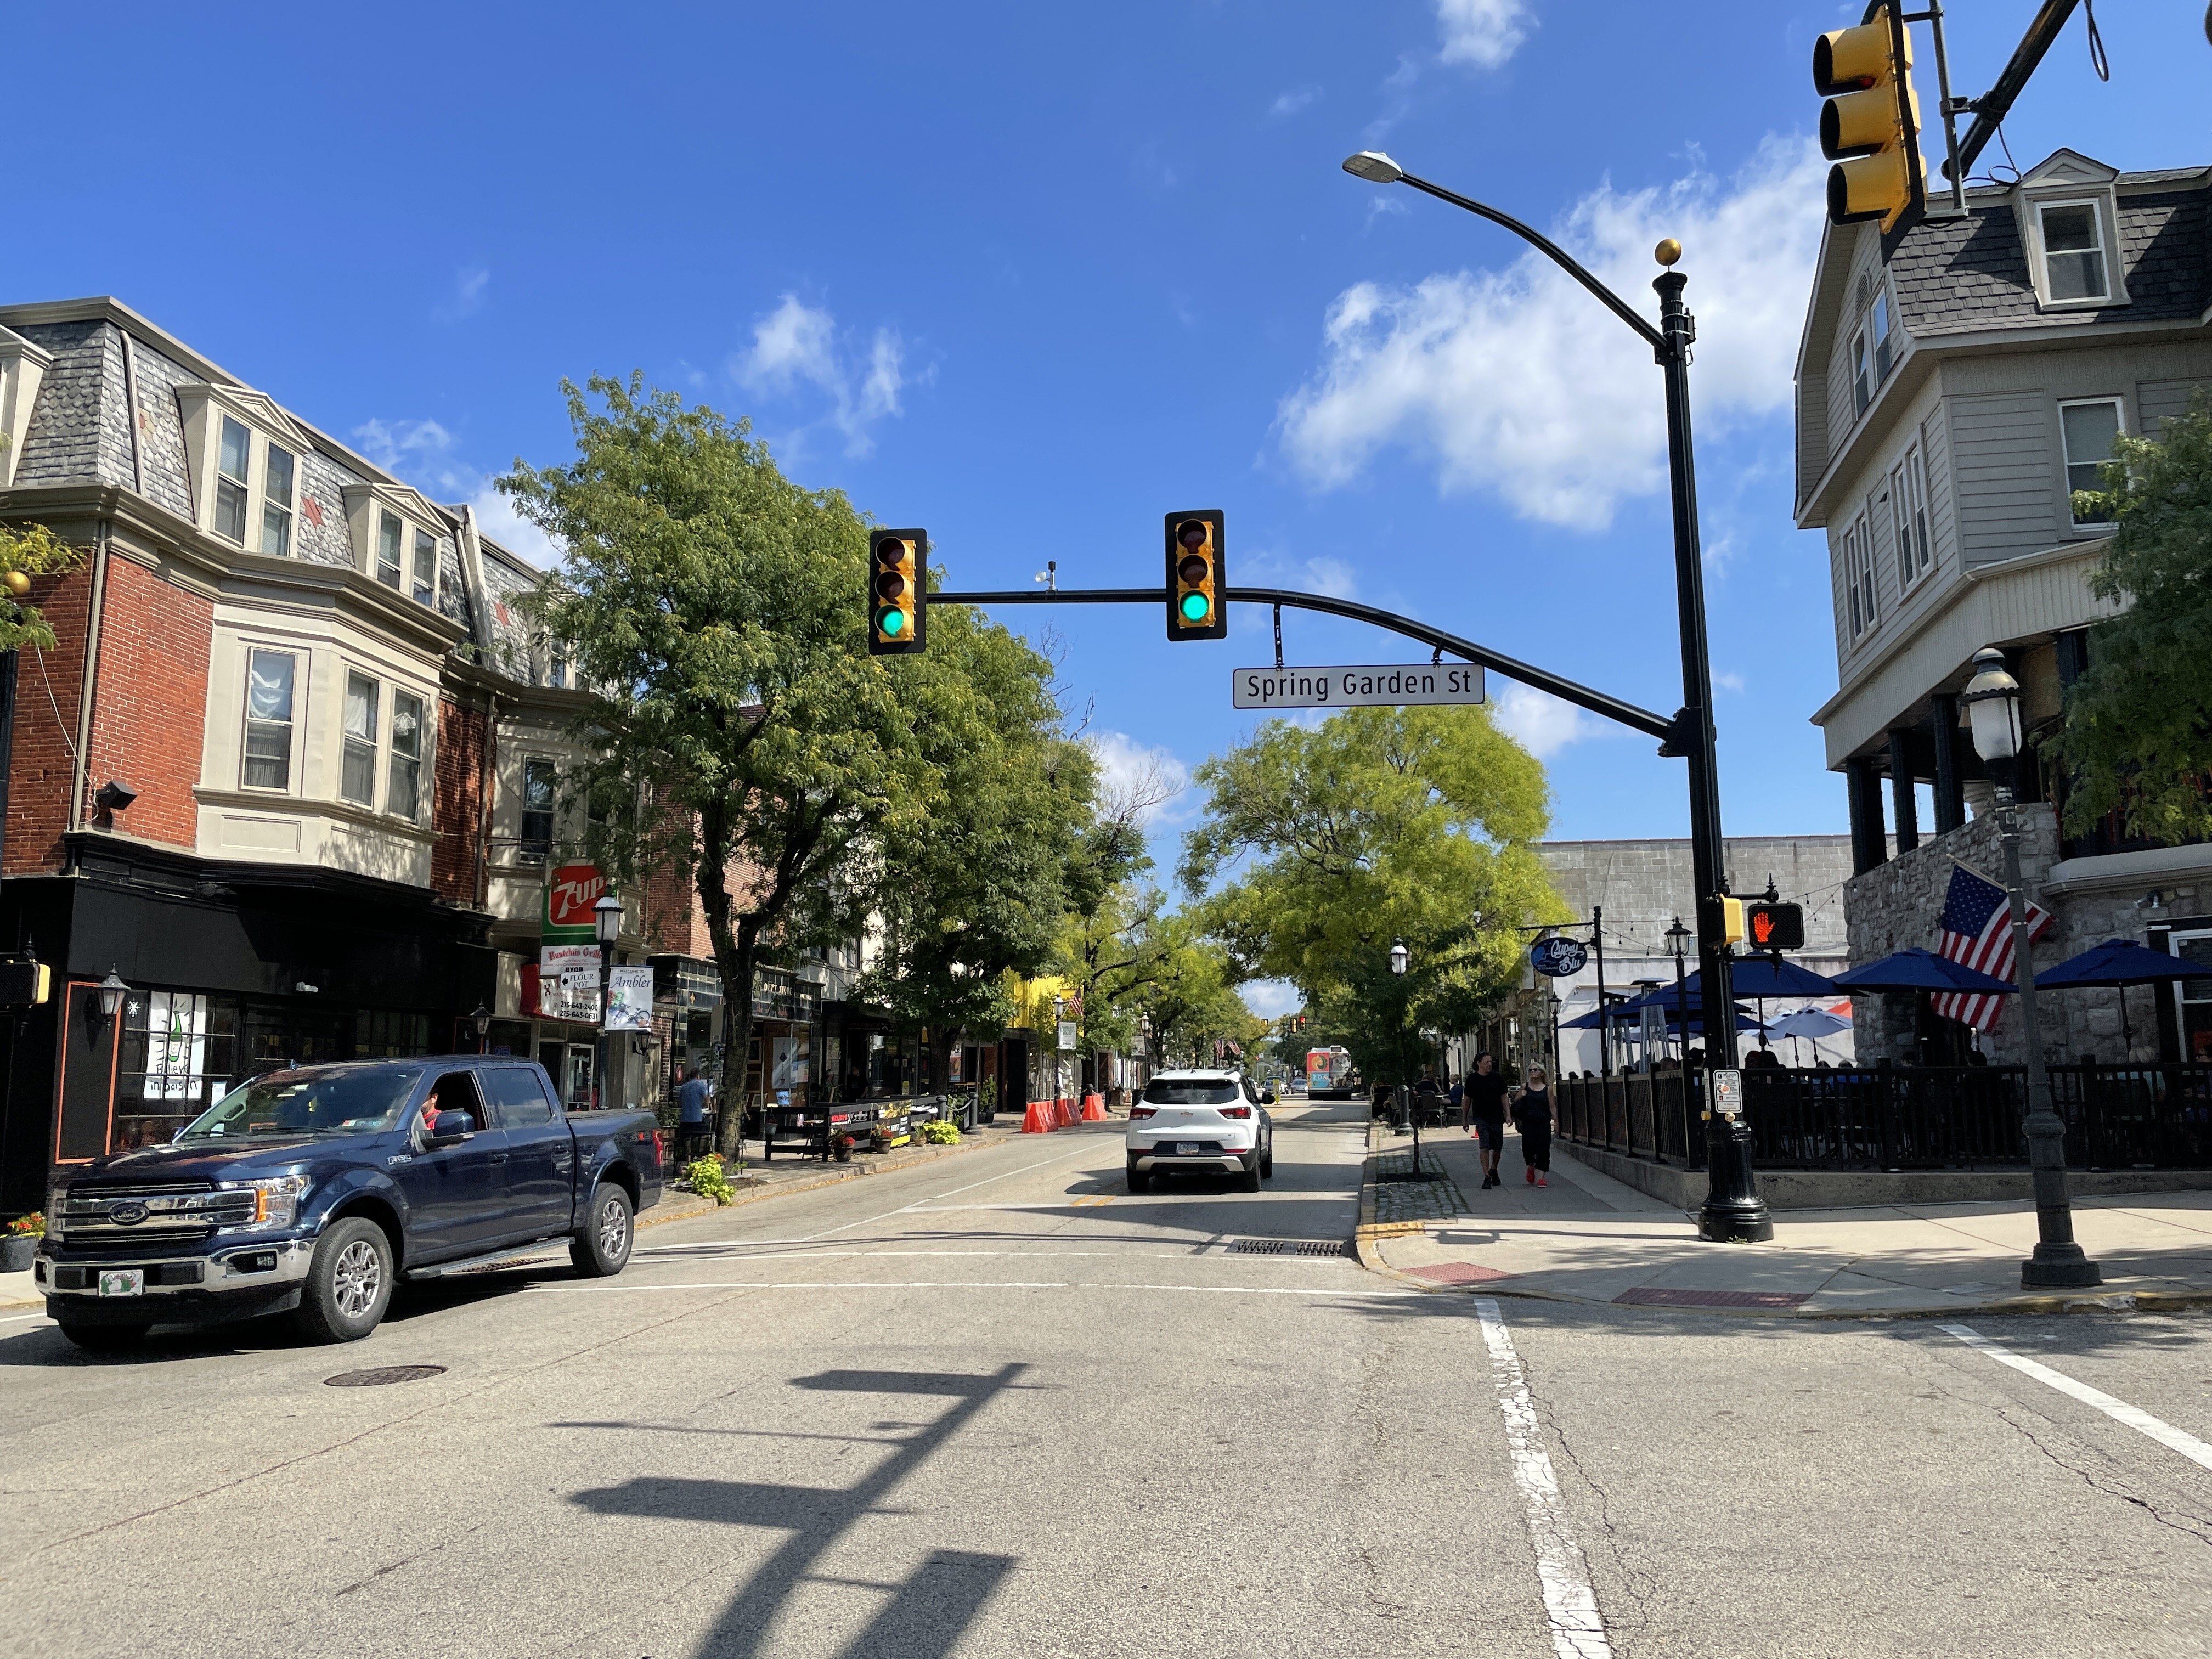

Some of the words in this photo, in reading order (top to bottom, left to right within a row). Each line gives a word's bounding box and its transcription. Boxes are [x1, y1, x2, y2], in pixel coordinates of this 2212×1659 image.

[1248, 672, 1329, 703] Spring
[1342, 670, 1435, 695] Garden
[1448, 670, 1471, 693] St
[1550, 939, 1585, 959] Gypsy
[1559, 956, 1581, 974] Blu
[569, 973, 594, 982] FLOUR
[610, 975, 652, 989] Ambler
[560, 1001, 599, 1011] 215-643-2400
[560, 1010, 598, 1019] 215-643-0631
